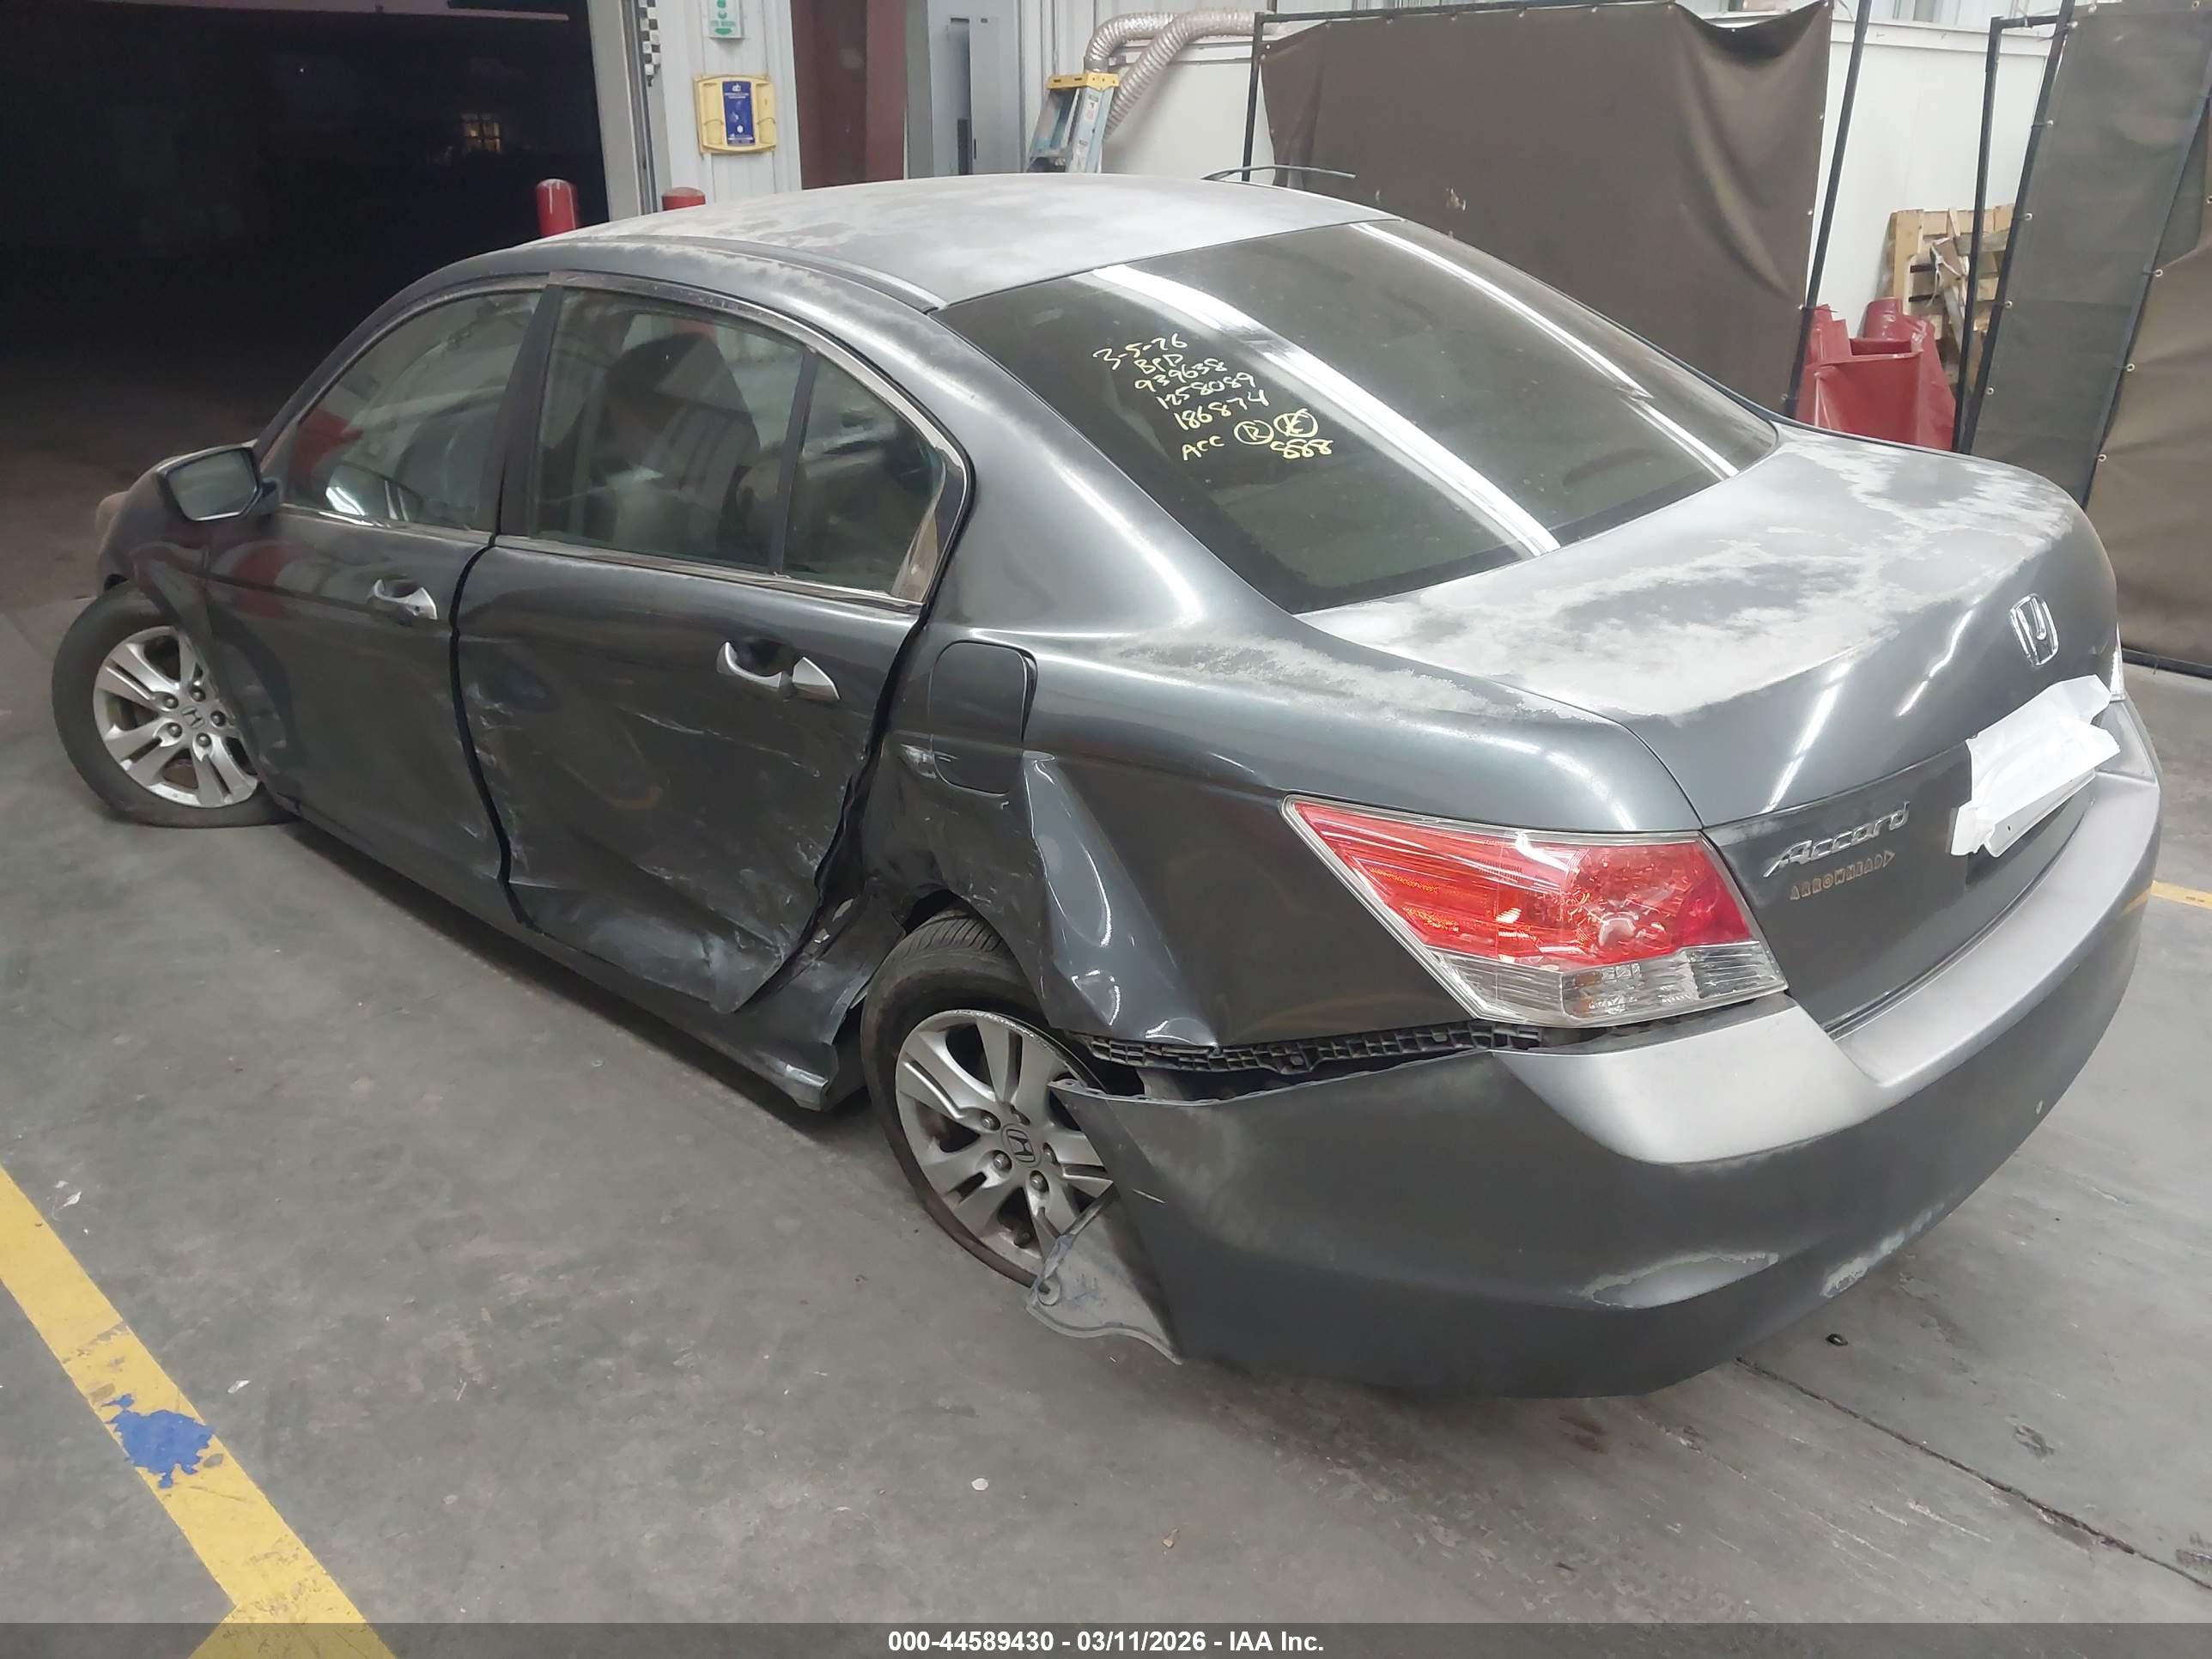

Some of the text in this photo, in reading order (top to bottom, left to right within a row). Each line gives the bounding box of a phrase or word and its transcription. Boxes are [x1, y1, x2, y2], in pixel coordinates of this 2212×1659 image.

[1092, 332, 1188, 370] 3-5-26
[1173, 389, 1270, 431] 186874
[1763, 800, 1911, 878] Accord
